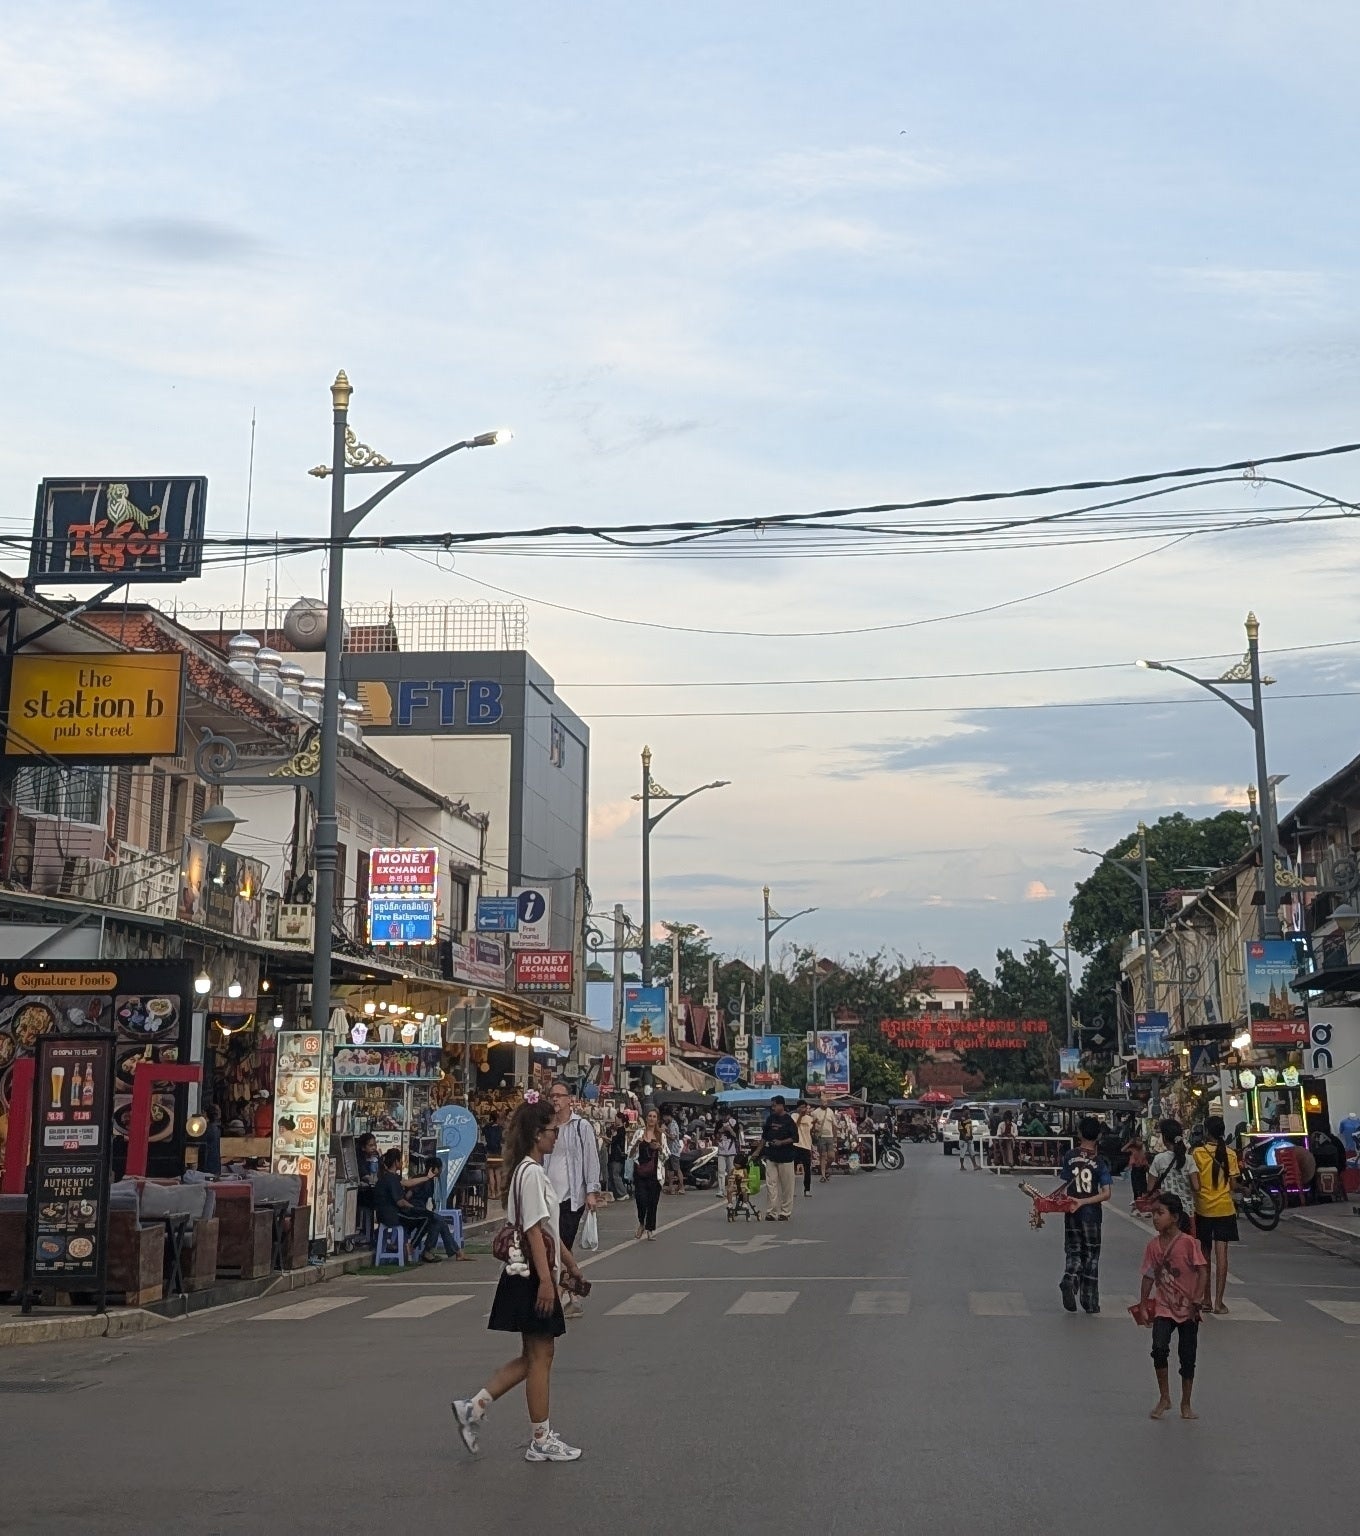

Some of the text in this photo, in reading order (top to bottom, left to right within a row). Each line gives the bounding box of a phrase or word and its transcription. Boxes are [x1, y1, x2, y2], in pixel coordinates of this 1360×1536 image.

[68, 519, 169, 572] Tiger
[79, 669, 112, 688] the
[23, 689, 164, 719] station b
[397, 679, 504, 726] FTB
[53, 722, 134, 741] pub street
[378, 853, 429, 864] MONEY
[376, 866, 431, 874] EXCHANGE
[374, 912, 430, 921] Free Bathroom
[521, 955, 567, 965] MONEY
[519, 965, 569, 973] EXCHANGE
[0, 972, 9, 986] b
[21, 974, 76, 989] Signature
[1290, 1023, 1306, 1035] 74
[306, 1040, 317, 1051] 6$
[897, 1039, 1028, 1048] RIVERSIDE NIGHT MARKET
[652, 1047, 664, 1056] 59
[303, 1080, 315, 1090] 5$
[43, 1178, 94, 1188] AUTHENTIC
[1072, 1166, 1093, 1194] 18
[54, 1187, 83, 1197] TASTE
